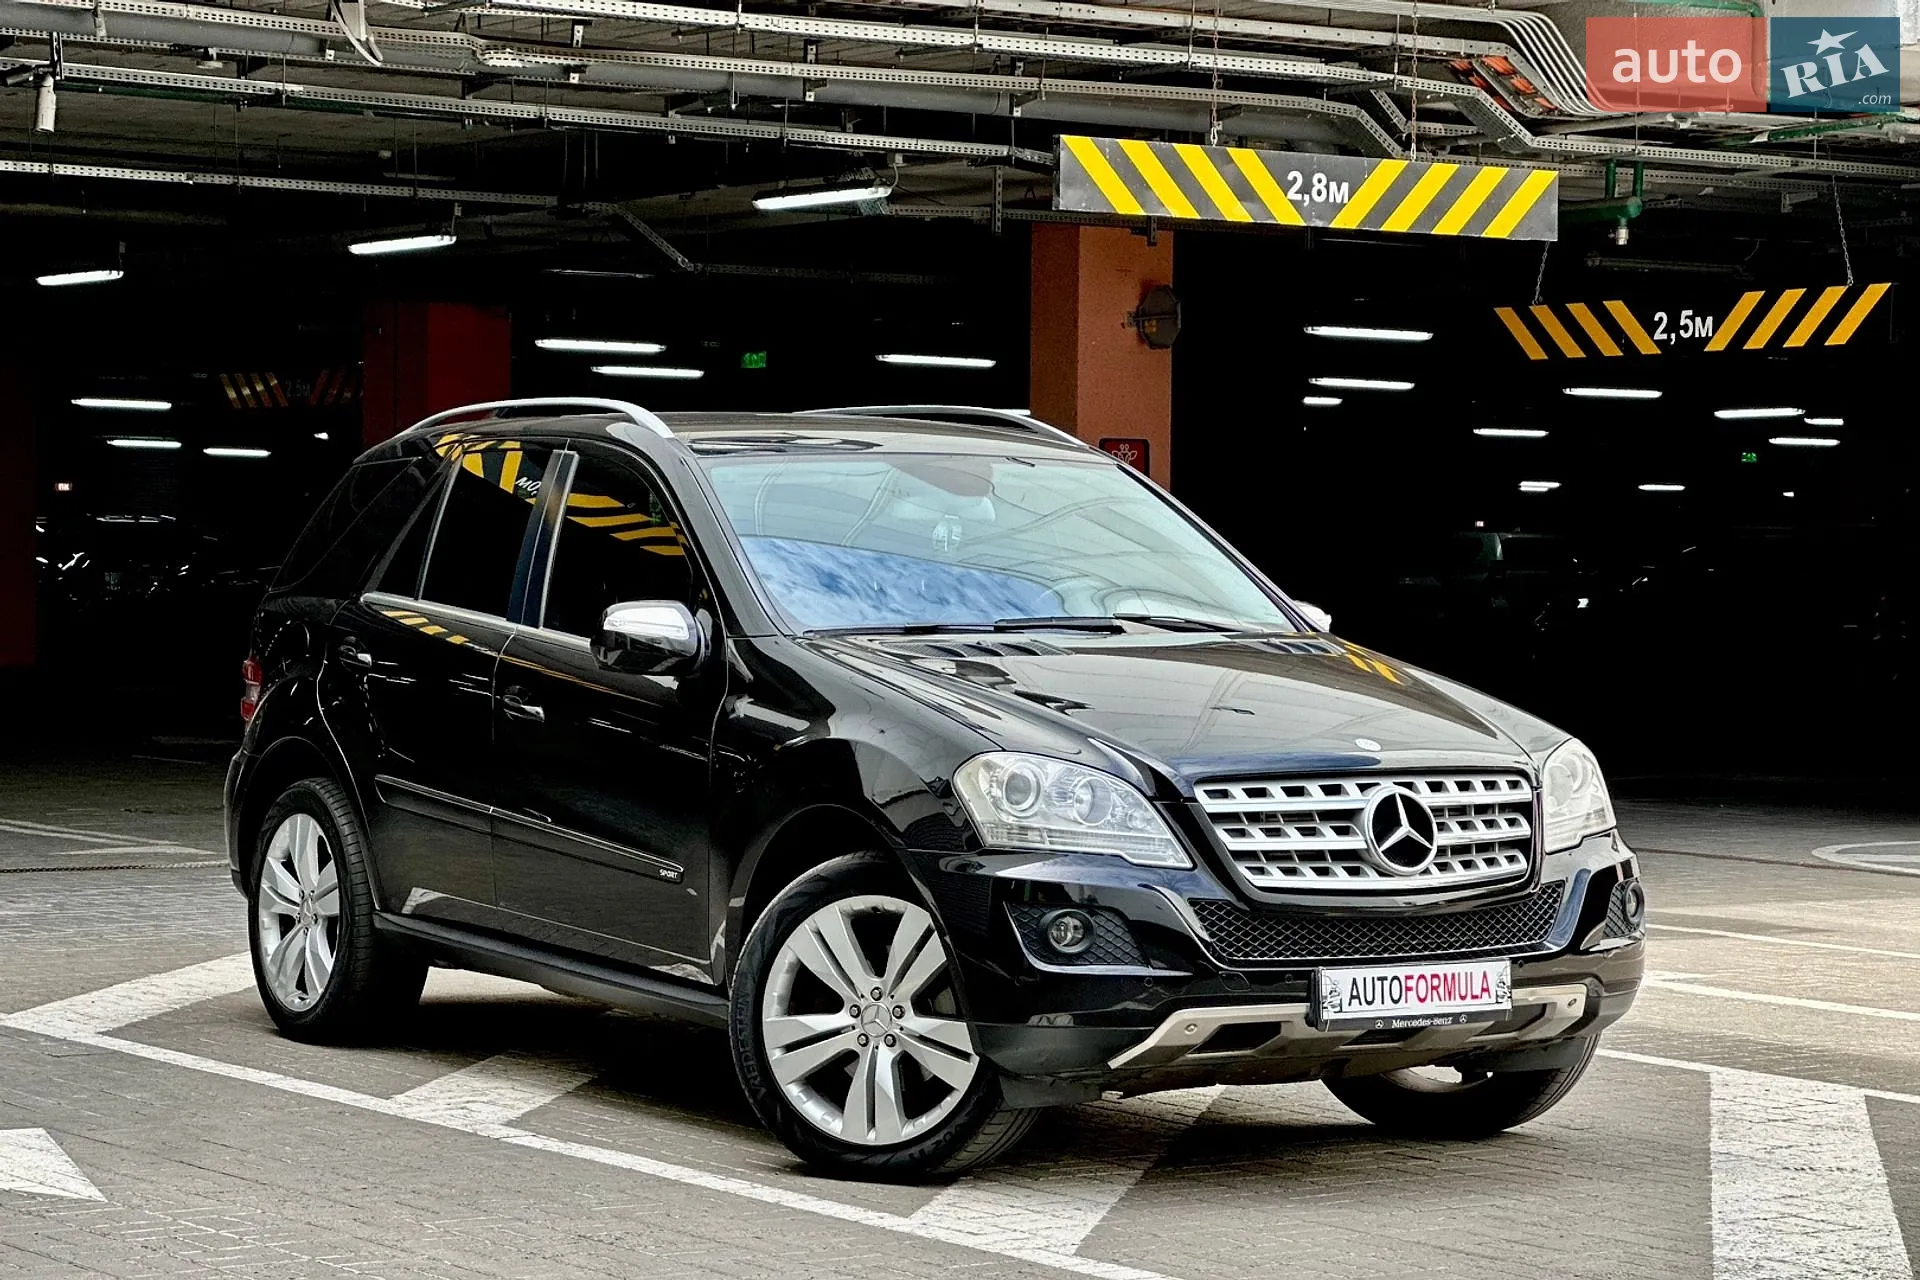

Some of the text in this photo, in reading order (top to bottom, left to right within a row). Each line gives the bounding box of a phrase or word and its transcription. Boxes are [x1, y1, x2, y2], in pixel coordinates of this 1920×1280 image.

[660, 868, 678, 879] SPORT
[1348, 970, 1492, 1007] AUTOFORMULA
[1391, 1016, 1453, 1029] Mercedes-Benz
